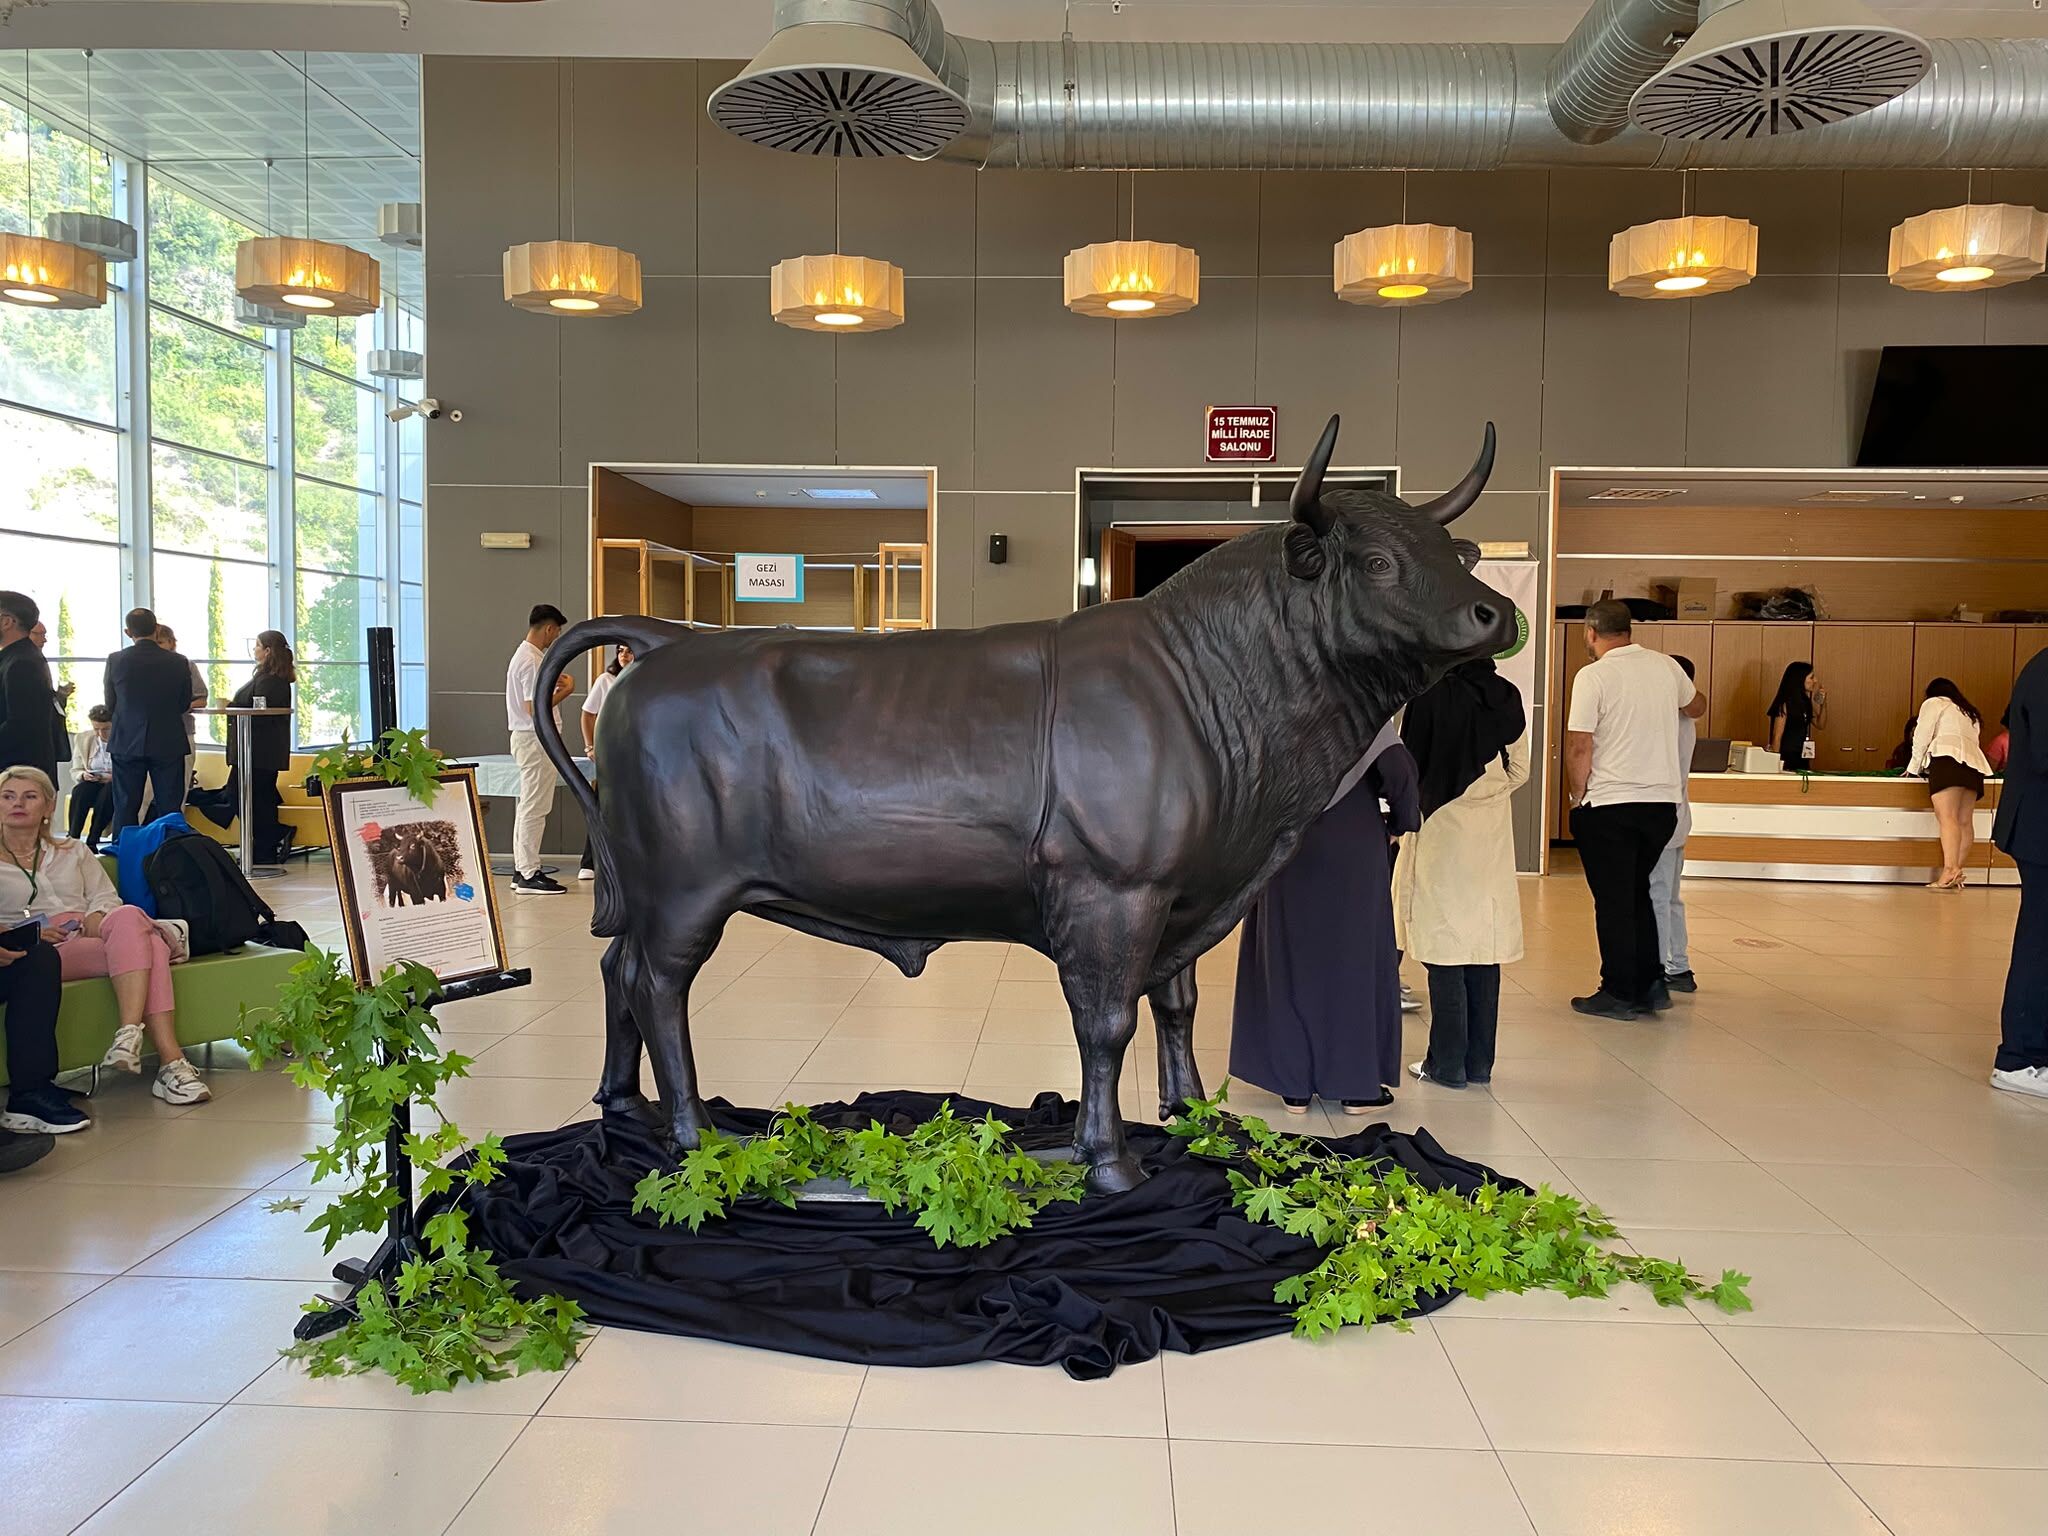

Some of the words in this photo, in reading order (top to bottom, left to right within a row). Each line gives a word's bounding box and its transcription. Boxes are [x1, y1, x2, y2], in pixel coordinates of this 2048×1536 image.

[1213, 417, 1225, 426] 15
[1227, 416, 1269, 426] TEMMUZ
[1211, 427, 1237, 439] MİLLİ
[1239, 427, 1270, 439] İRADE
[1219, 442, 1261, 451] SALONU
[756, 562, 777, 572] GEZİ
[748, 578, 785, 587] MASASI
